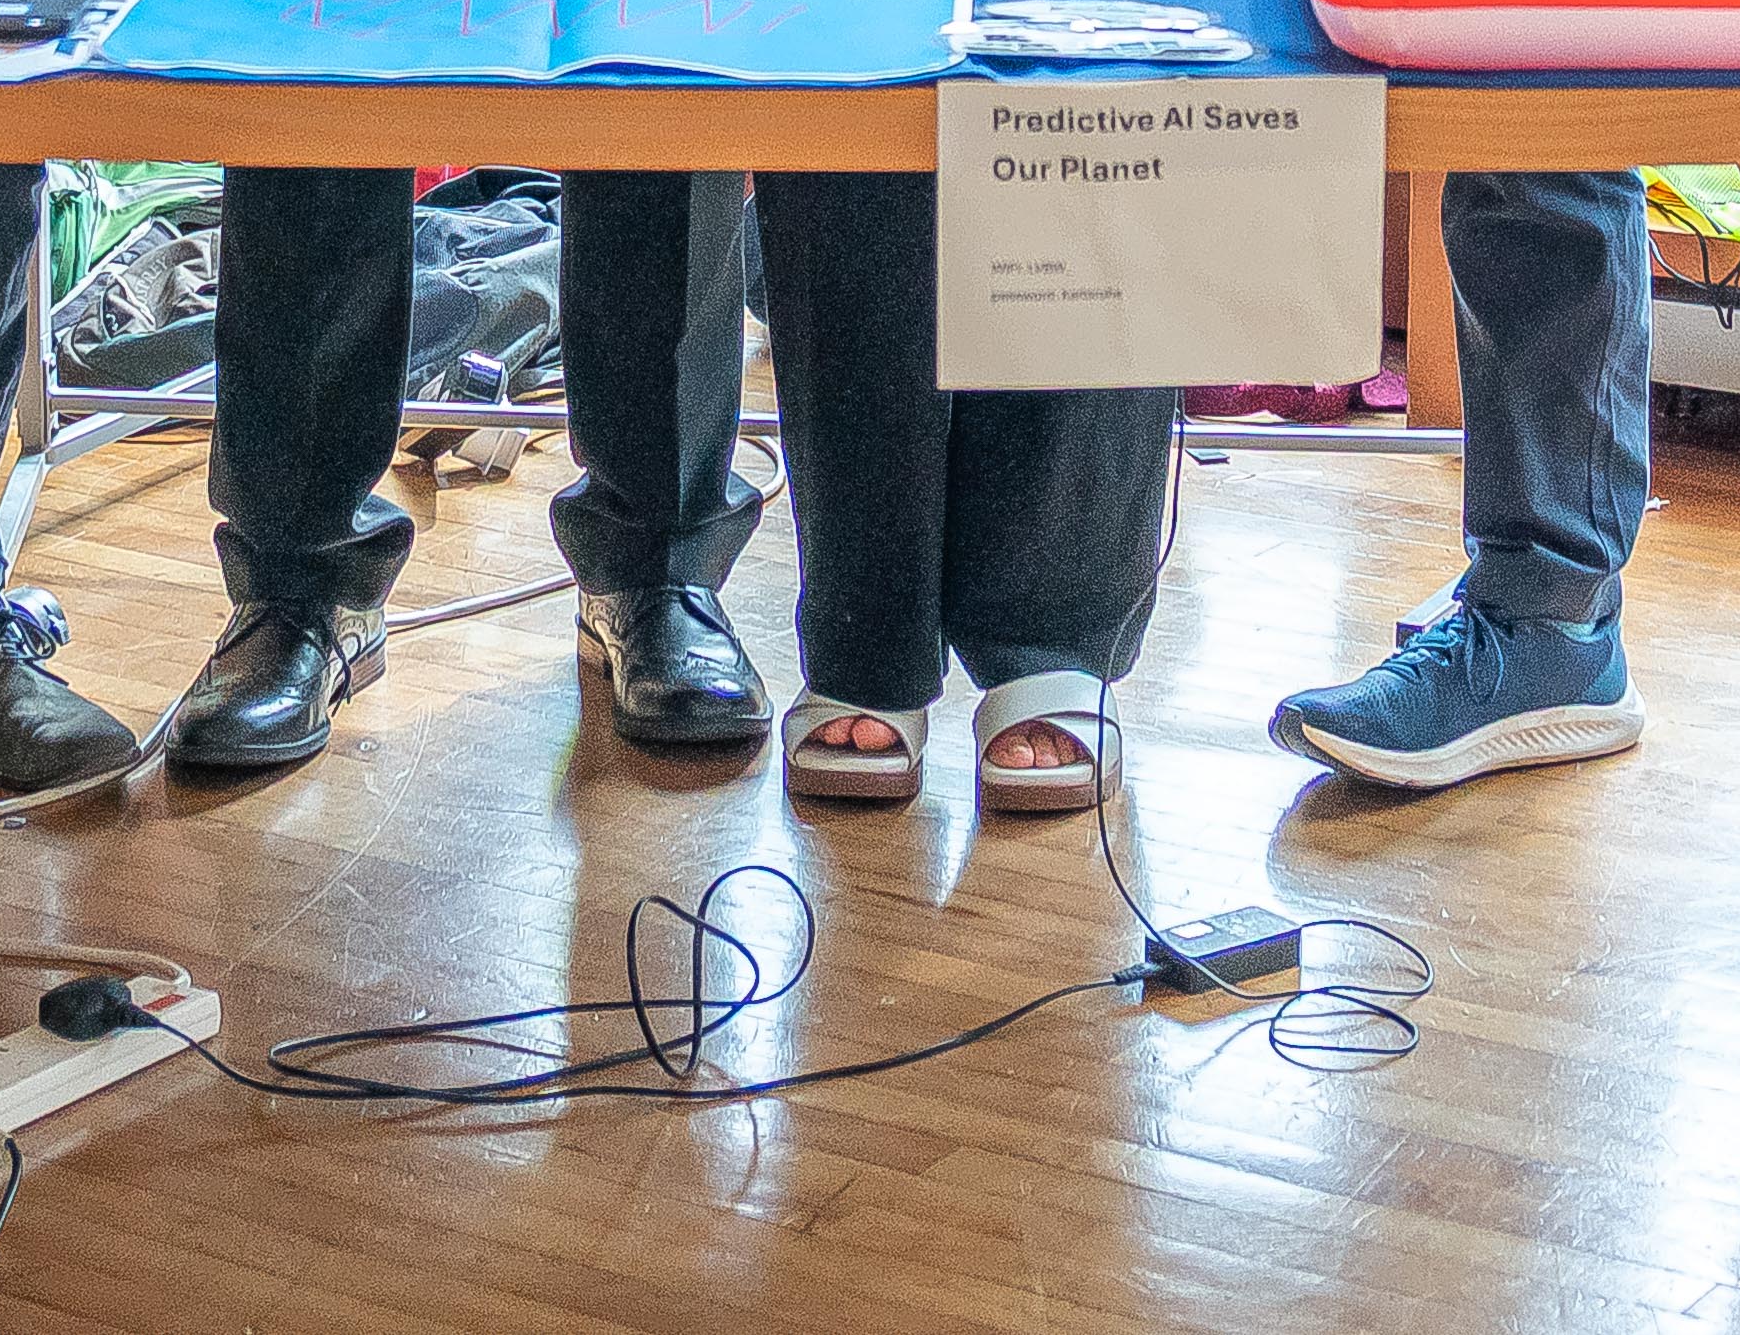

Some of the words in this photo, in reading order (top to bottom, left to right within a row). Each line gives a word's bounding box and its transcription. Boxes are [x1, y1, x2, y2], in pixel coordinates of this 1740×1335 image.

[993, 106, 1154, 133] Predictive
[1164, 106, 1192, 130] AI
[1204, 106, 1300, 131] Saves
[993, 156, 1053, 182] Our
[1060, 156, 1166, 182] Planet
